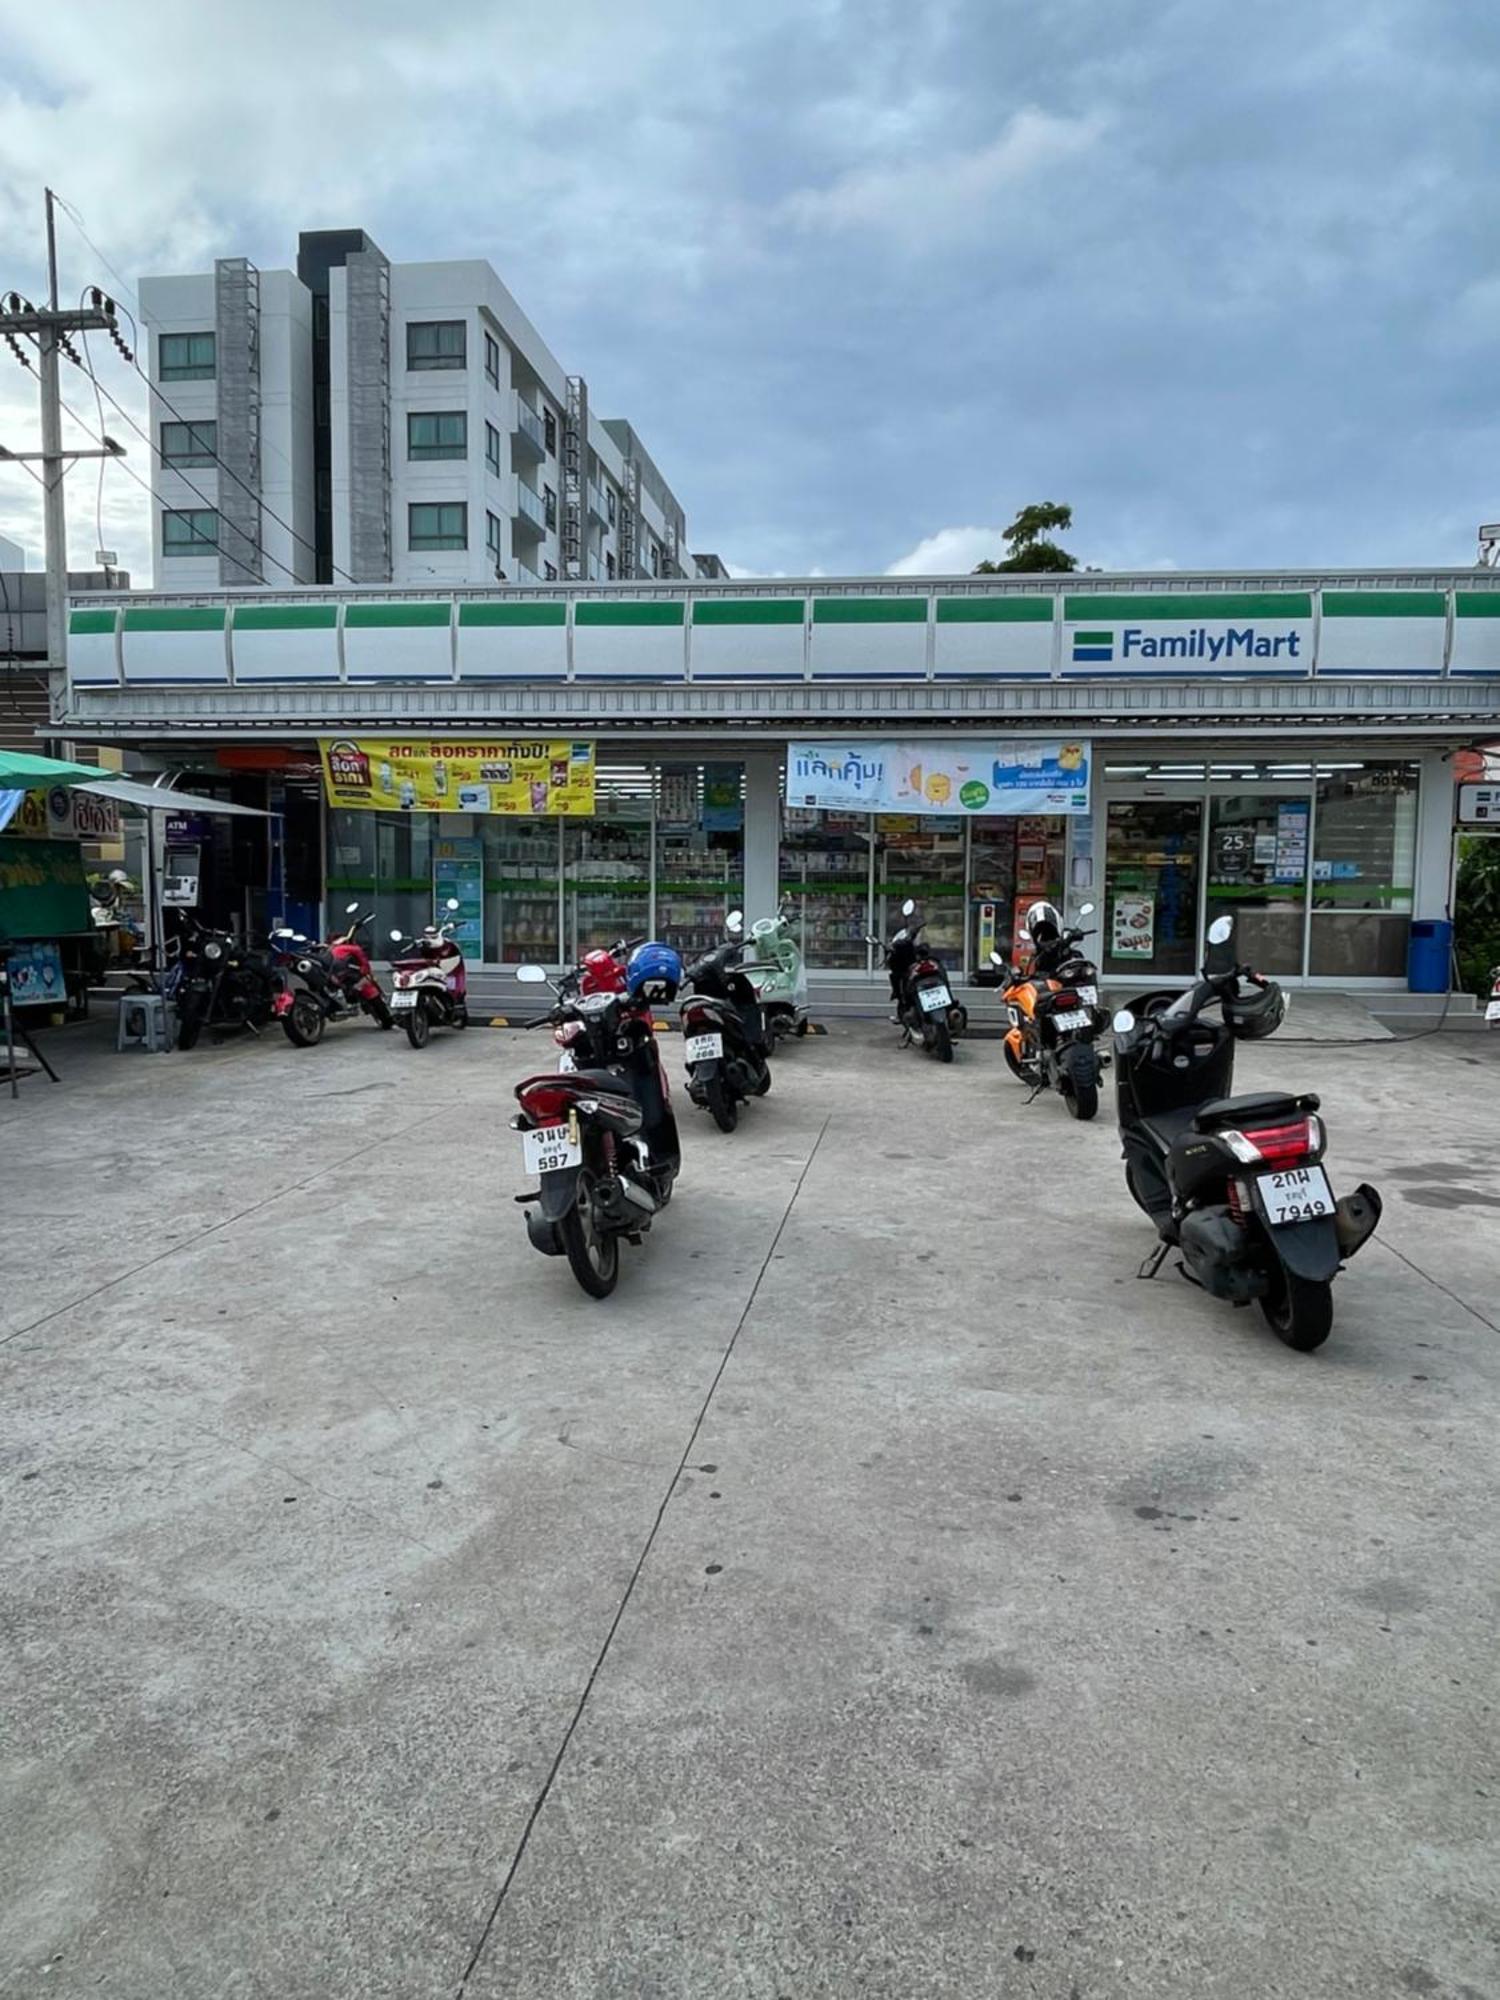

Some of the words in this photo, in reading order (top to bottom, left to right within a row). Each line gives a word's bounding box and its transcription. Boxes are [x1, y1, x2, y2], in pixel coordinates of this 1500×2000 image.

[1123, 628, 1300, 662] FamilyMart
[167, 820, 187, 831] ATM
[538, 1153, 568, 1170] 597
[1276, 1201, 1326, 1222] 7949
